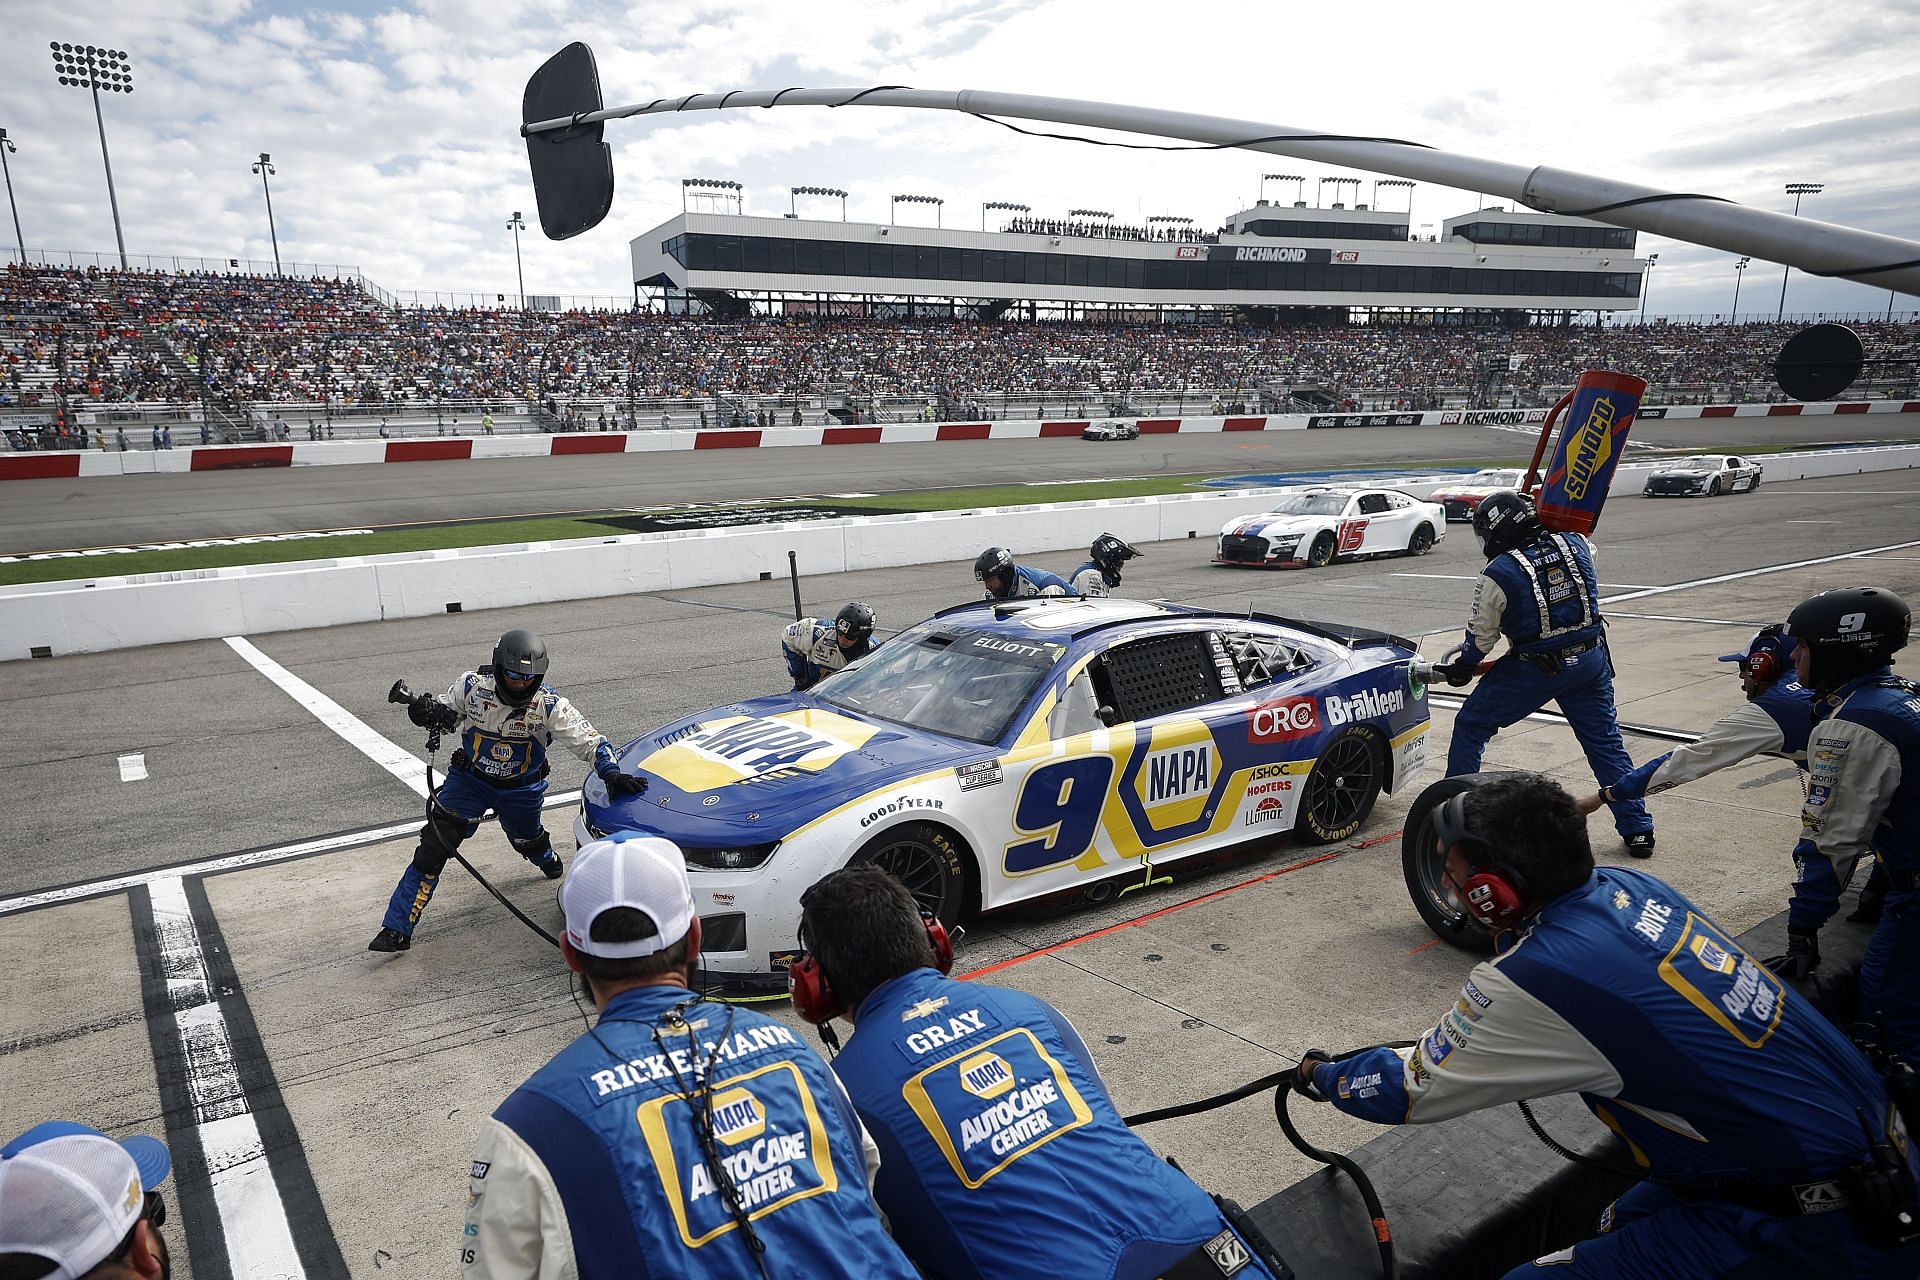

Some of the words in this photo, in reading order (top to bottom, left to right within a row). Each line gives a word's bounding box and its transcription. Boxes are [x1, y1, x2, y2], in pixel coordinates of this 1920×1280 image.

[1178, 247, 1197, 257] RR
[1235, 247, 1307, 262] RICHMOND
[1340, 251, 1357, 261] RR
[230, 259, 239, 268] E
[1442, 413, 1460, 424] RR
[1463, 411, 1525, 424] RICHMOND
[1528, 411, 1545, 422] RR
[1568, 401, 1614, 497] SUNOCO
[1488, 506, 1500, 522] 9
[1338, 518, 1370, 553] 15
[996, 550, 1005, 561] 9
[1837, 612, 1866, 633] 9
[973, 637, 1044, 657] ELLIOTT
[1252, 702, 1314, 736] CRC
[1346, 726, 1375, 741] EAGLE
[494, 745, 511, 757] NAPA
[485, 765, 512, 776] CENTER
[969, 761, 993, 774] NASCAR
[1150, 747, 1209, 802] NAPA
[1248, 764, 1290, 781] ASHOC
[965, 774, 977, 785] CUP
[977, 771, 997, 783] SERIES
[1247, 780, 1292, 797] HOOTERS
[860, 795, 943, 828] GOODYEAR
[1001, 753, 1117, 879] 9
[1307, 811, 1360, 840] GOODYEAR
[931, 834, 961, 876] EAGLE
[712, 892, 736, 901] Hendrick
[1634, 898, 1673, 942] BOVE
[906, 1009, 986, 1055] GRAY
[965, 1060, 1009, 1091] NAPA
[712, 1098, 760, 1136] NAPA
[959, 1078, 1059, 1152] AUTOCARE
[990, 1108, 1053, 1156] CENTER
